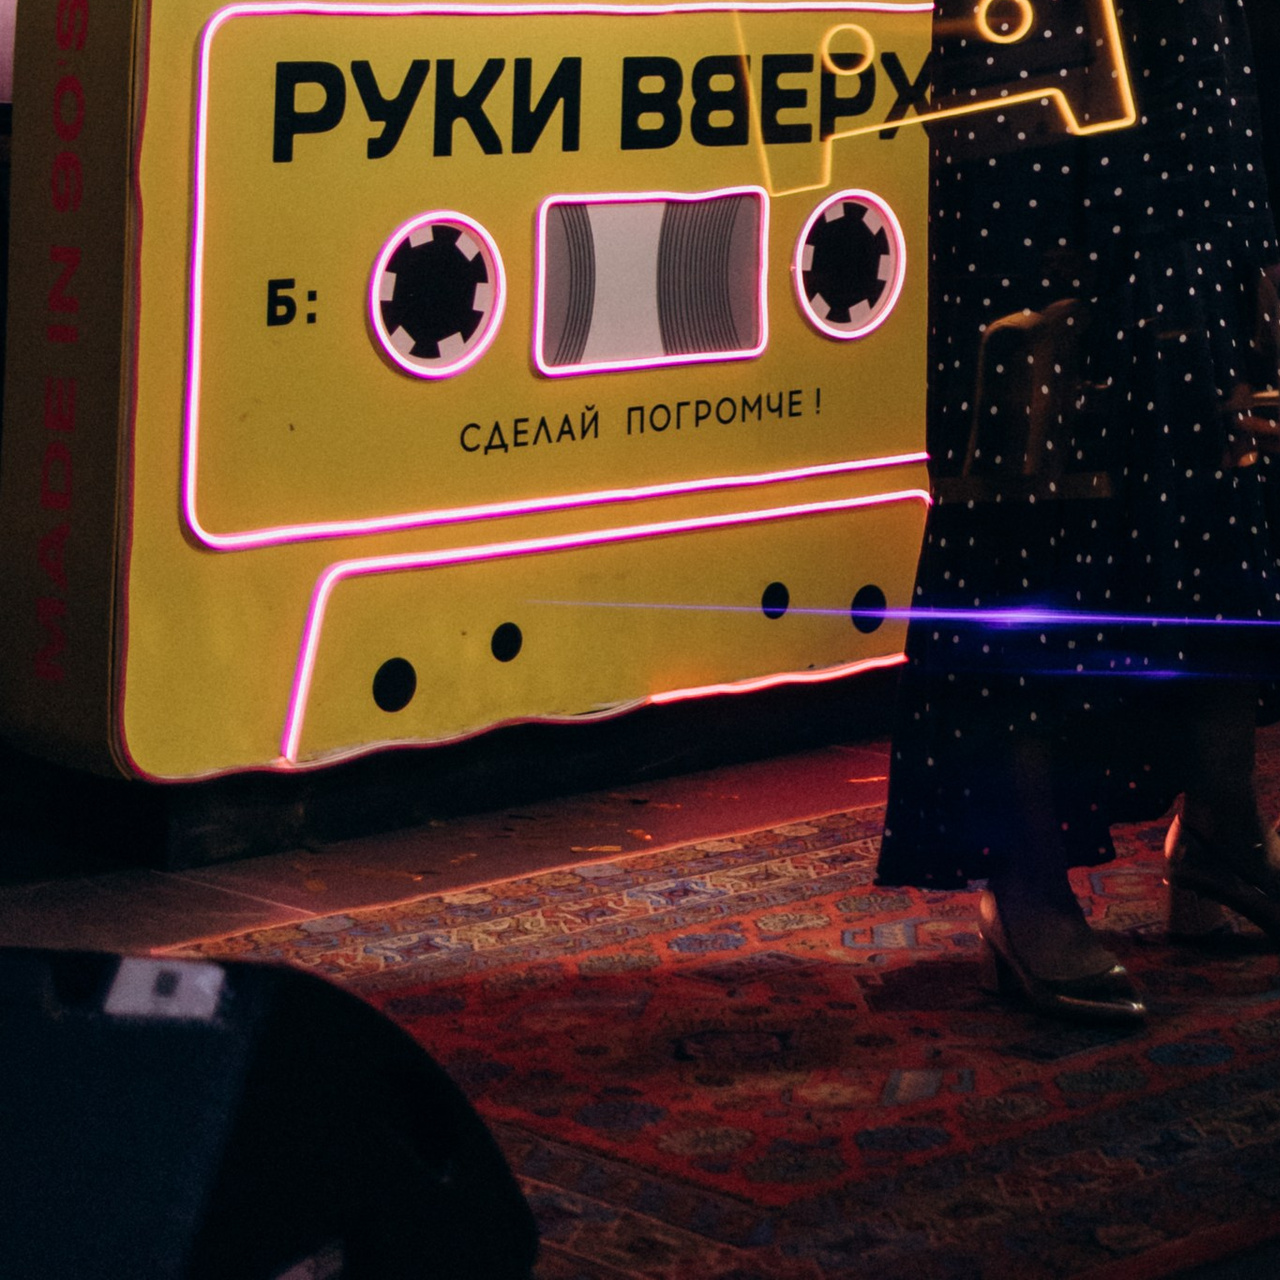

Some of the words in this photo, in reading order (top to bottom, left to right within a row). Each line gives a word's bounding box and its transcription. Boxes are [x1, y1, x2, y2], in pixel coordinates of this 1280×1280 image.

[272, 56, 583, 164] РУКИ
[619, 51, 932, 152] ВВЕРХ
[46, 245, 82, 345] IN
[266, 277, 318, 328] Б:
[459, 404, 600, 456] СДЕЛАЙ
[34, 375, 78, 681] MADE
